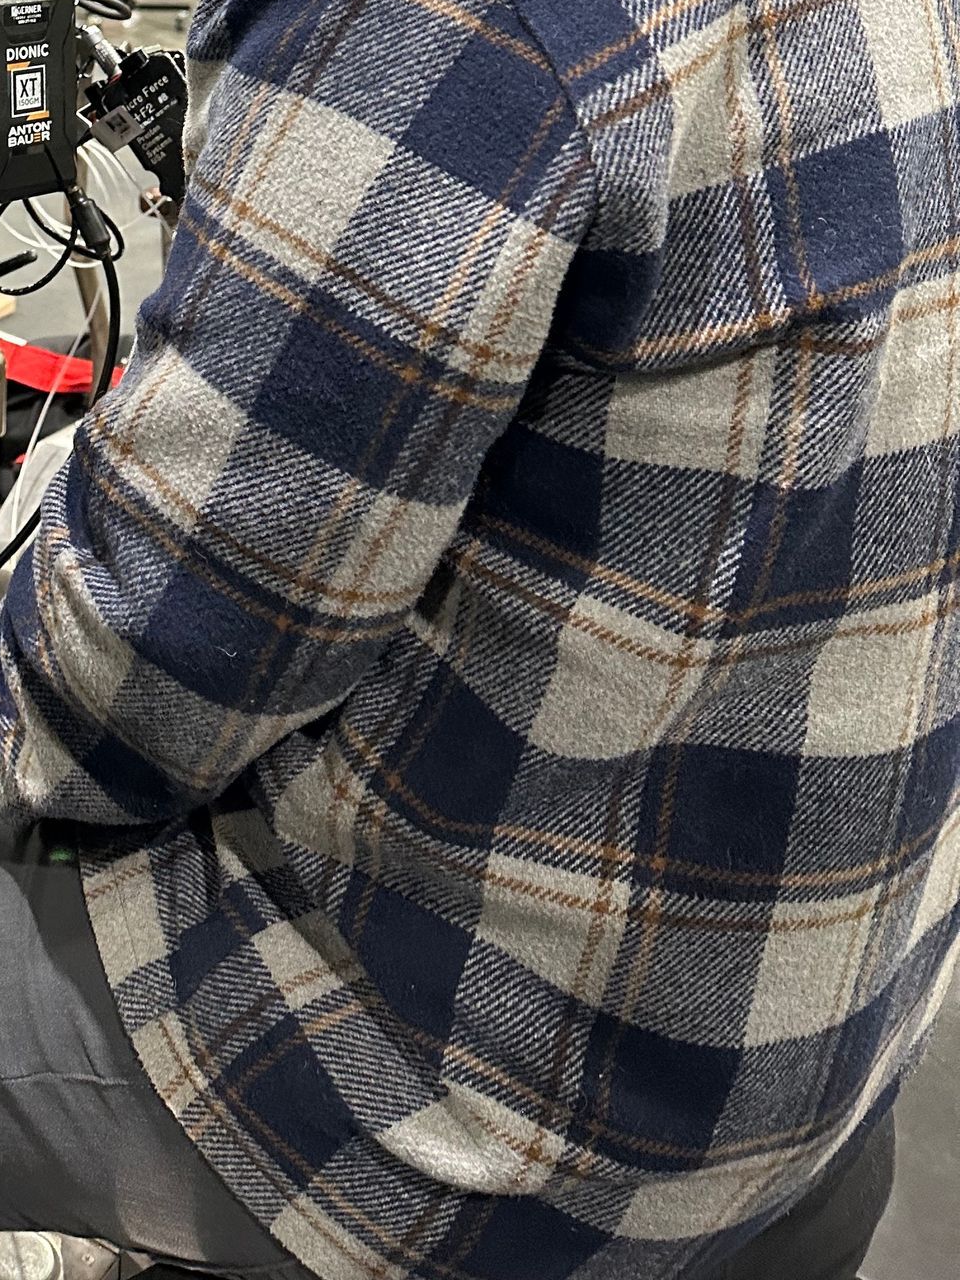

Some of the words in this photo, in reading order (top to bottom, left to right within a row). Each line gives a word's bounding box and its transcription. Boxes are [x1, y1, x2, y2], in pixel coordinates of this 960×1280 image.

[6, 43, 50, 62] DIONIC
[19, 77, 38, 99] XT
[141, 75, 169, 98] Force
[8, 121, 51, 136] ANTON
[7, 130, 51, 148] BAUER
